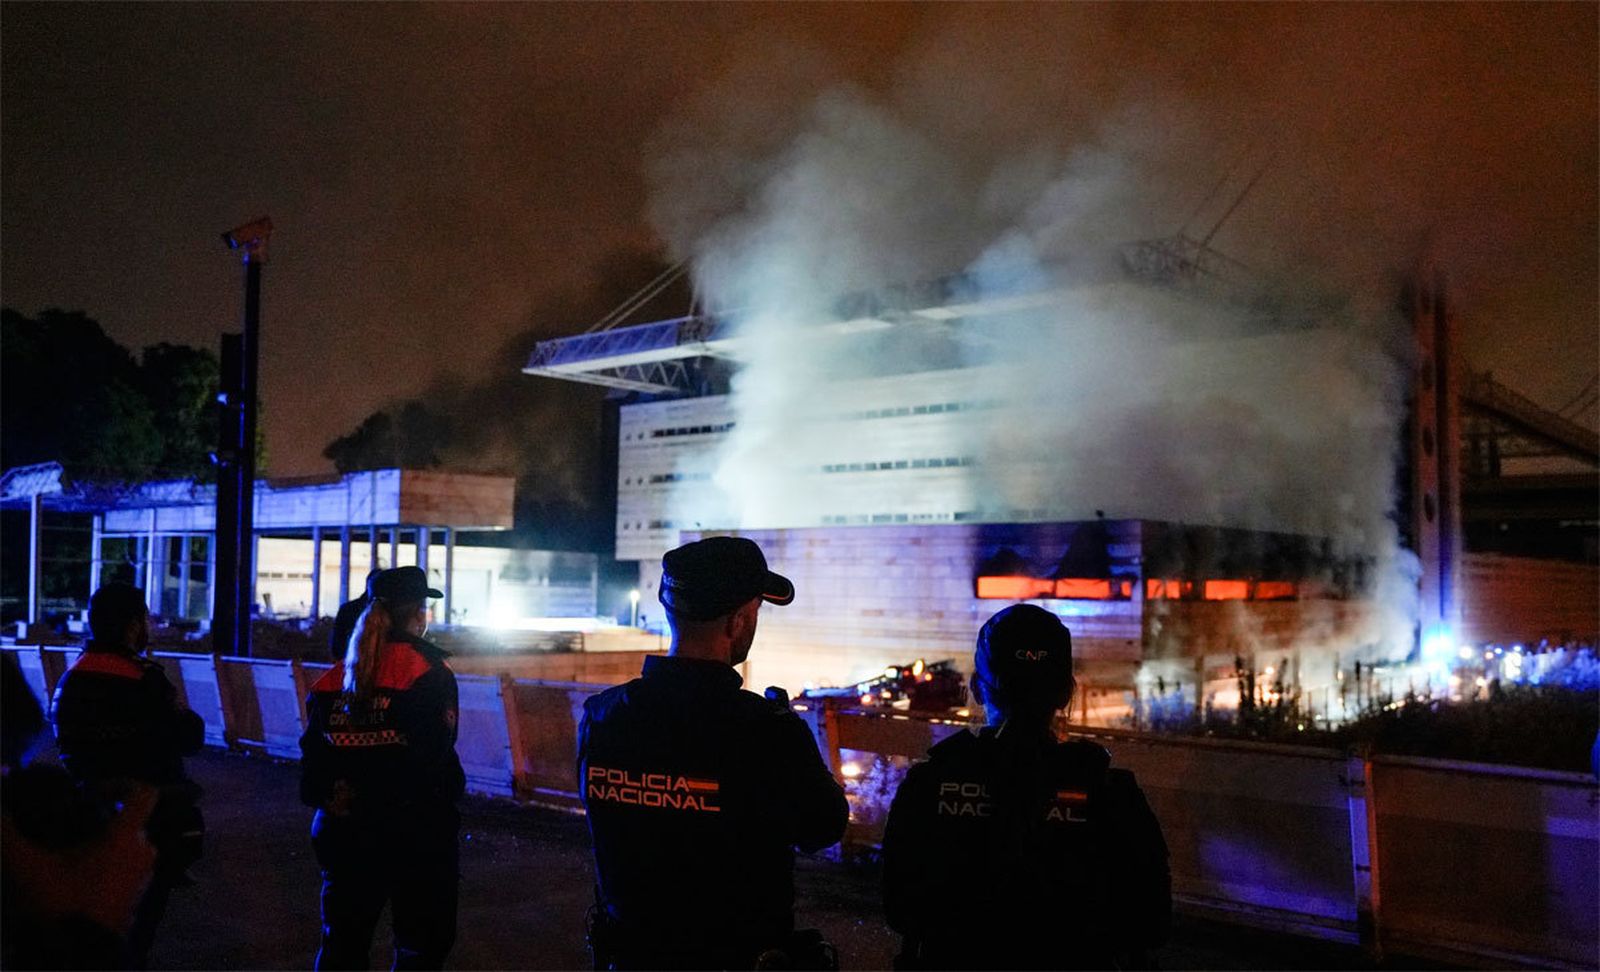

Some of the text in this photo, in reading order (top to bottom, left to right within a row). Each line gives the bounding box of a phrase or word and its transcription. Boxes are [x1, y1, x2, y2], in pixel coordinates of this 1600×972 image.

[1015, 648, 1049, 662] CNP
[588, 766, 690, 792] POLICIA
[588, 784, 721, 812] NACIONAL
